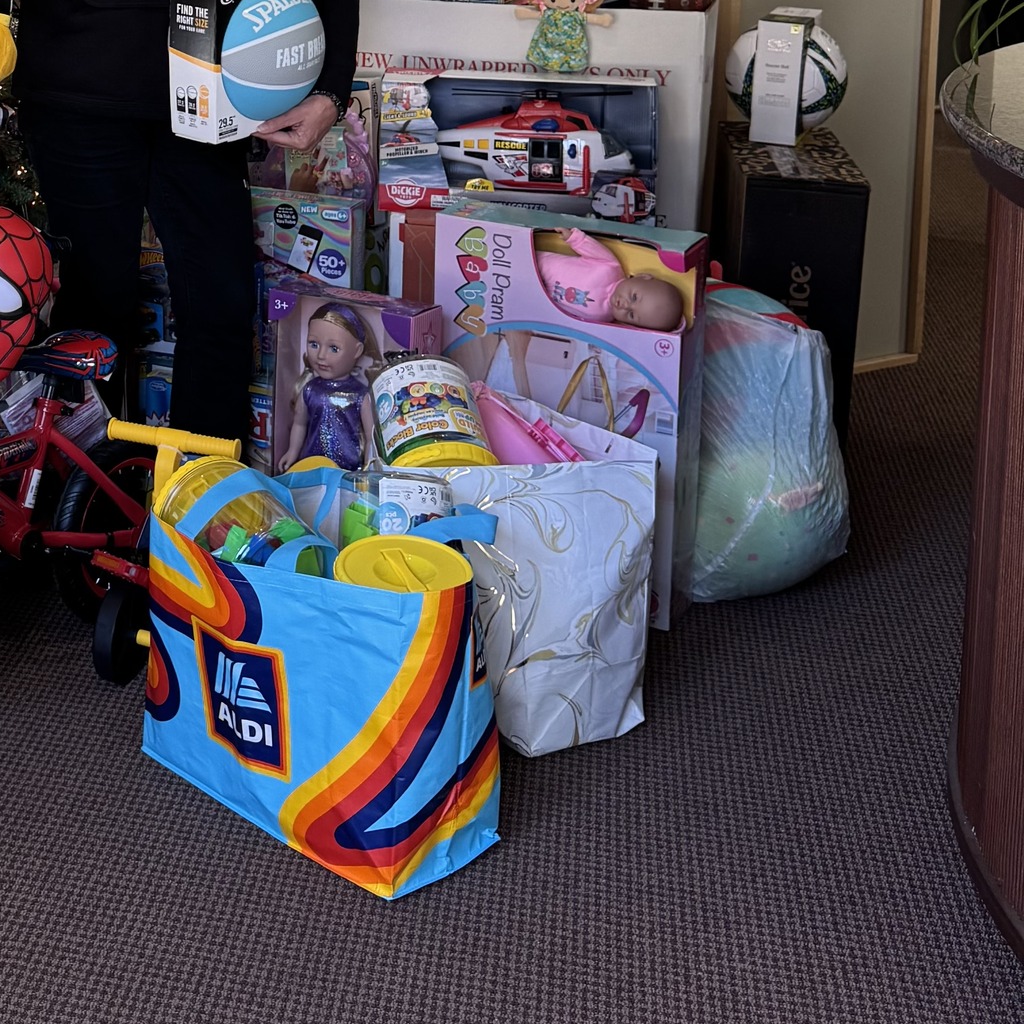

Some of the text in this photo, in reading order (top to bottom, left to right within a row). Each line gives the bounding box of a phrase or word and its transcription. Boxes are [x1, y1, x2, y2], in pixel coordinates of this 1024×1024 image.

[176, 3, 209, 19] FIND THE
[176, 14, 209, 29] RIGHT SIZE
[276, 43, 305, 69] FAST
[495, 141, 527, 150] RESCUE
[319, 254, 346, 269] 50+
[321, 267, 342, 276] Pieces
[491, 233, 513, 321] Doll Pram
[275, 299, 289, 310] 3+
[659, 341, 671, 356] 3+
[386, 420, 449, 450] Color Blocks
[381, 517, 403, 531] 20
[218, 701, 273, 747] ALDI
